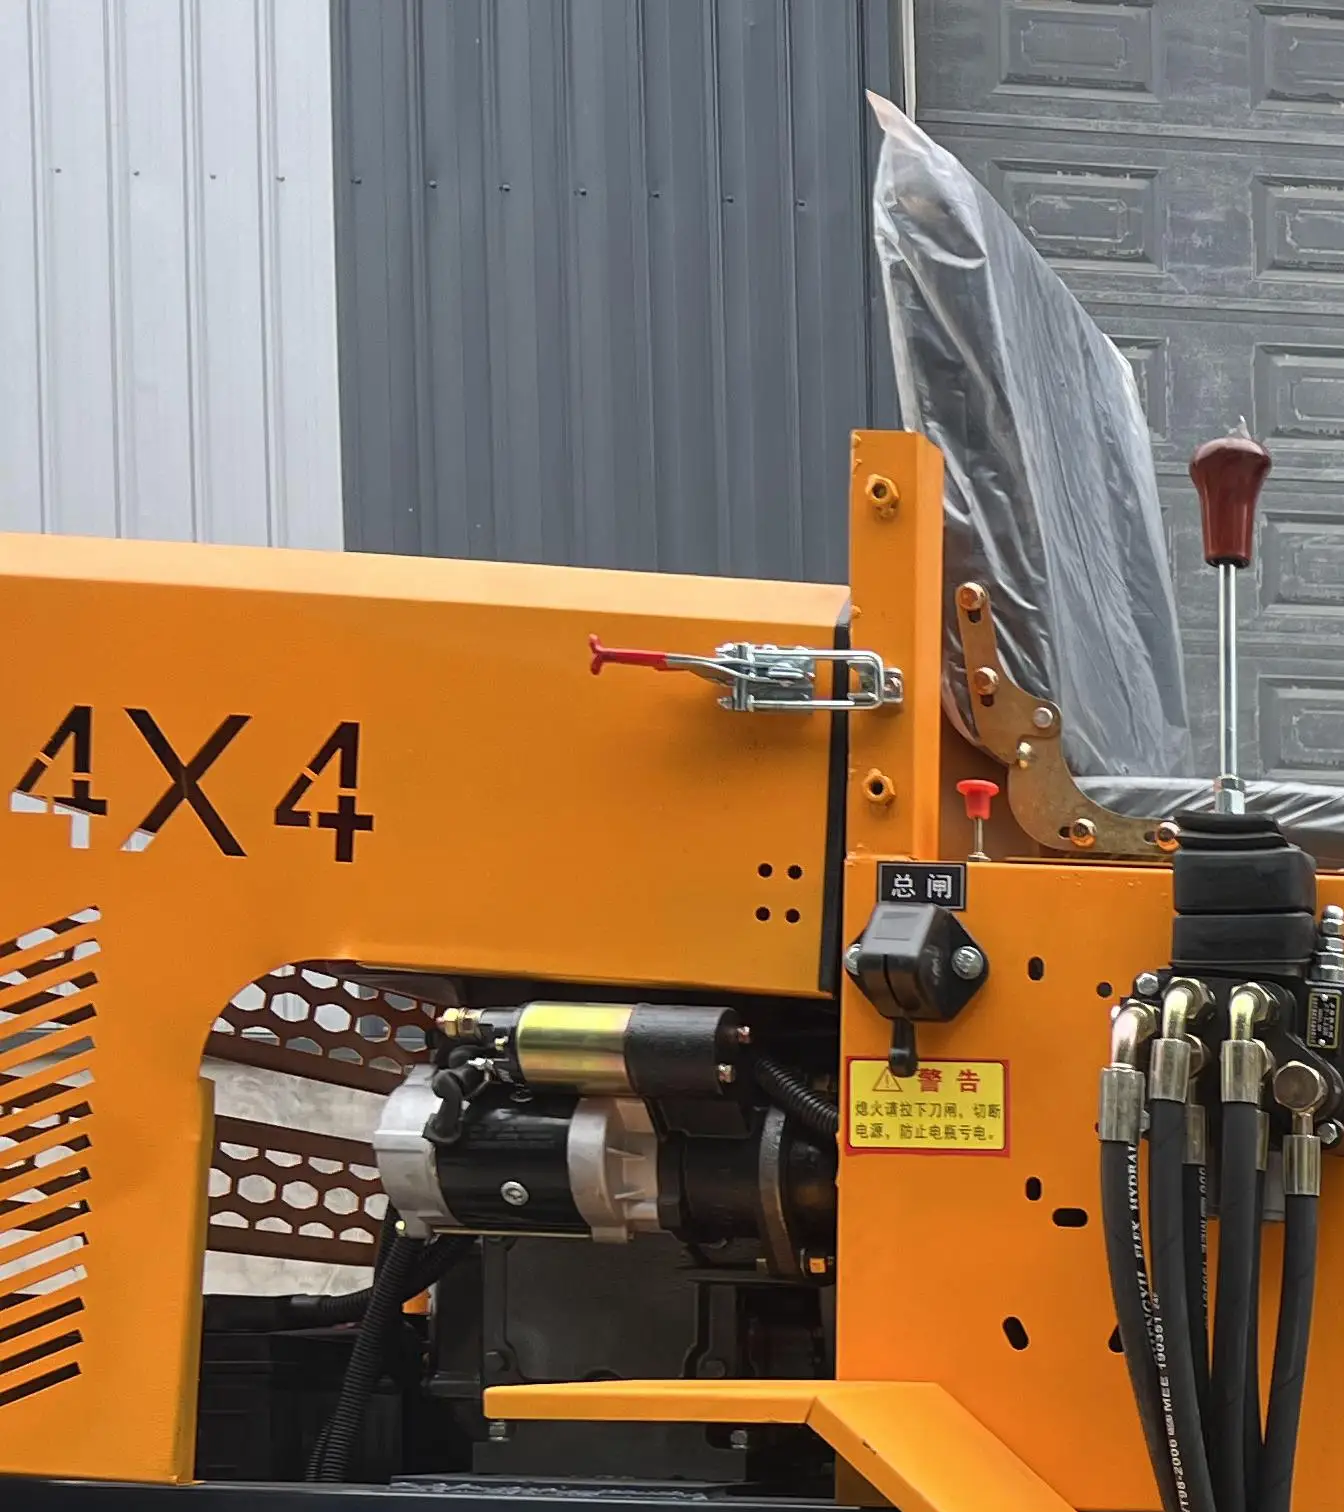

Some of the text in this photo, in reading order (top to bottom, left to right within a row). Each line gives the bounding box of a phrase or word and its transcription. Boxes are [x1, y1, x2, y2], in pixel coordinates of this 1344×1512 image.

[10, 705, 374, 863] 4X4
[891, 873, 953, 899] 总闸
[917, 1069, 981, 1093] 警告
